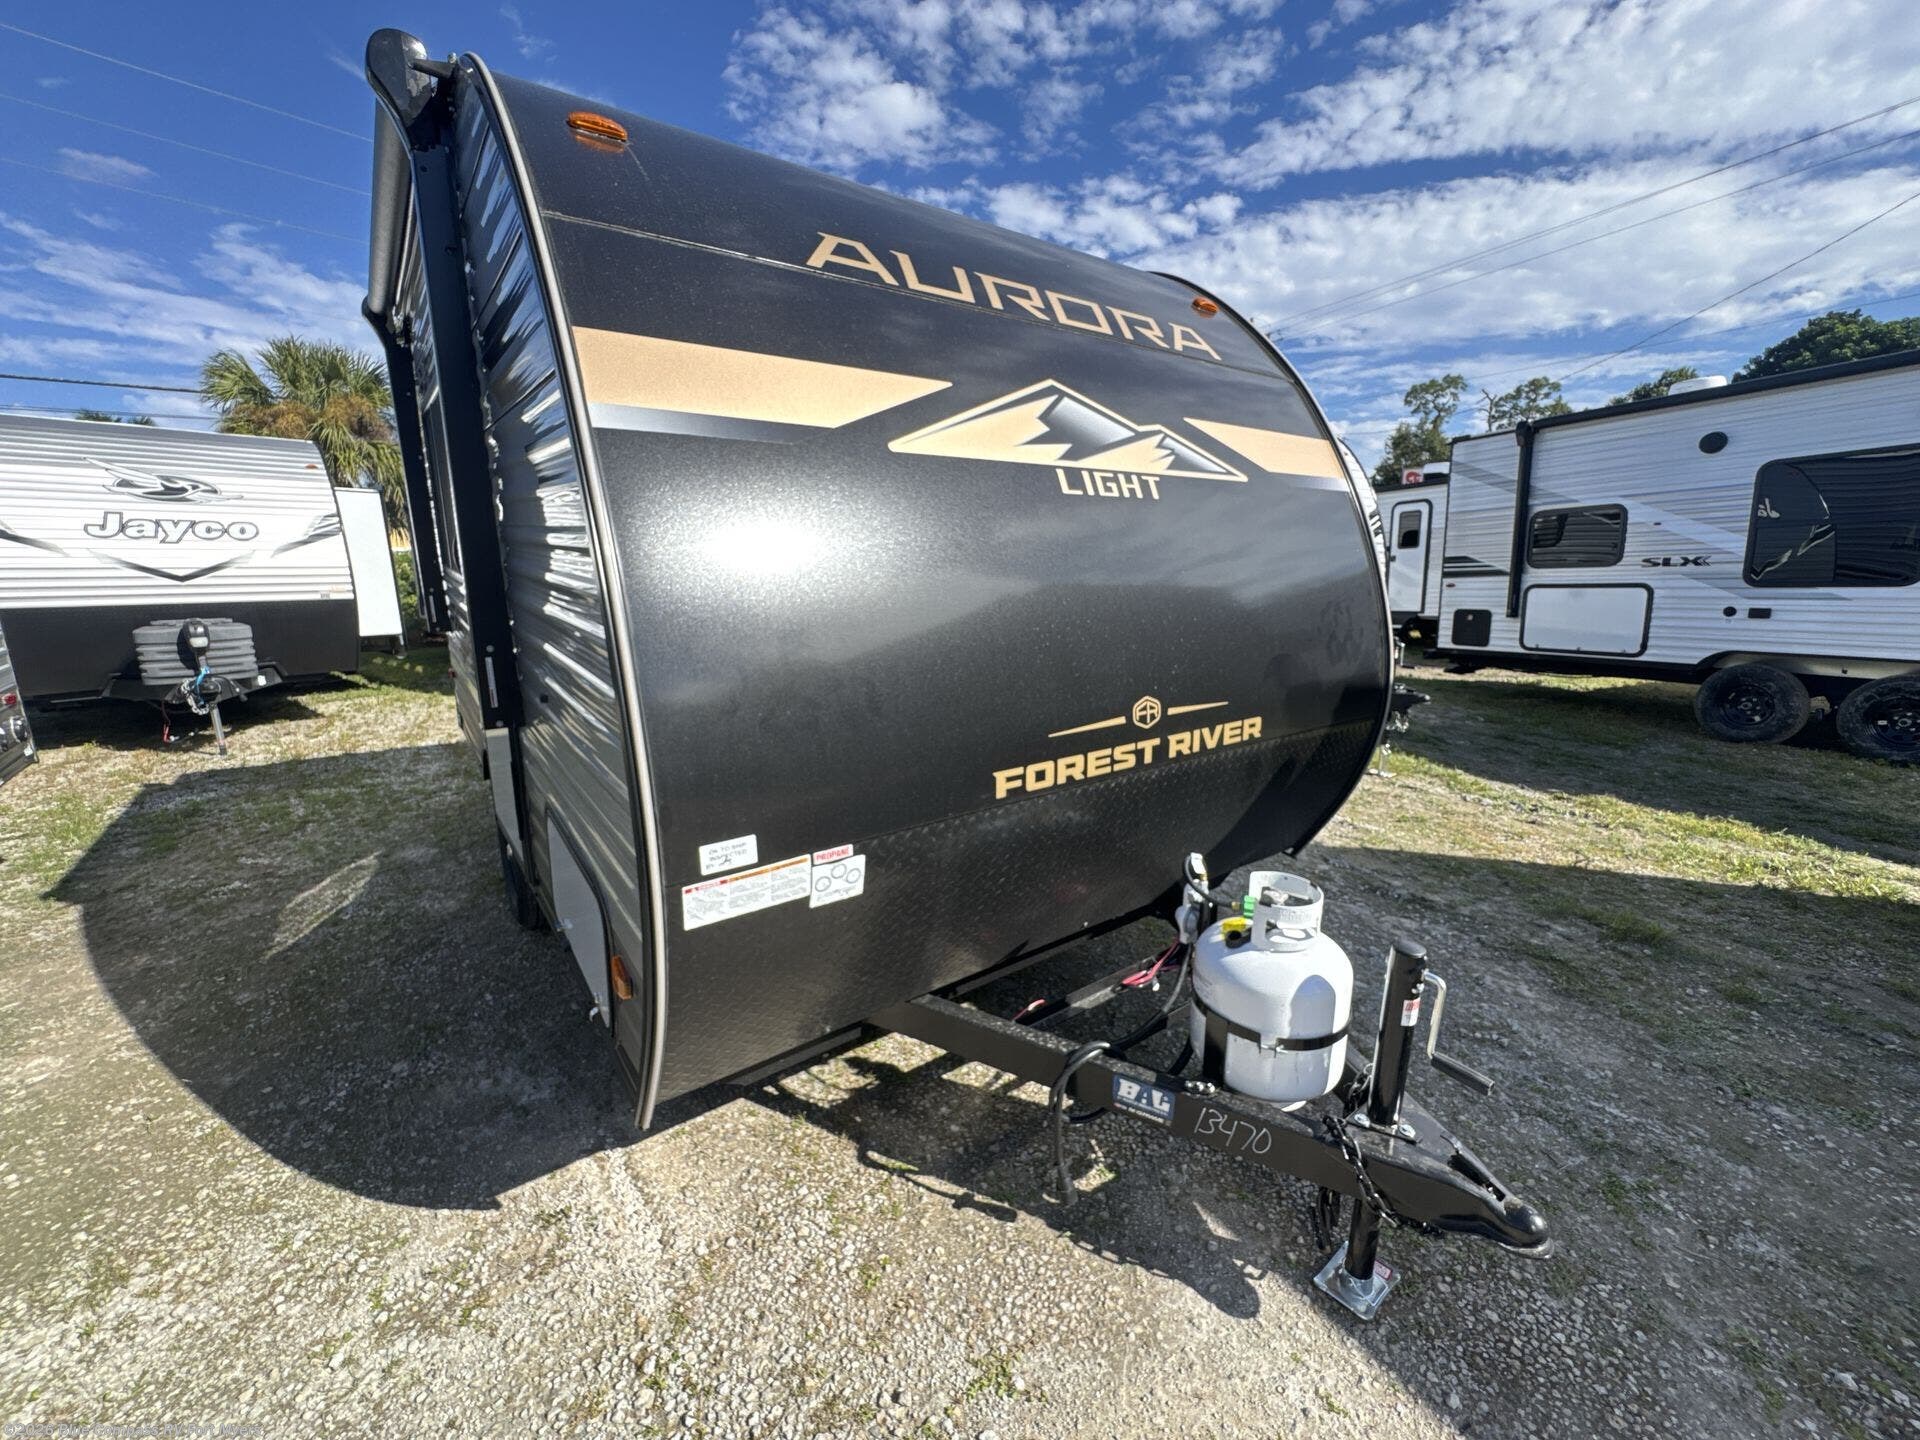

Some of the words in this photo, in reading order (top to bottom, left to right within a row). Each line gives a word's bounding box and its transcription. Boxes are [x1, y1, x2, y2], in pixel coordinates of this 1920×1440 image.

[806, 231, 1222, 361] AURORA
[1055, 467, 1161, 500] LIGHT
[83, 511, 260, 544] Jayco
[993, 737, 1161, 799] FOREST
[1167, 716, 1263, 759] RIVER
[1194, 1107, 1272, 1154] 13470
